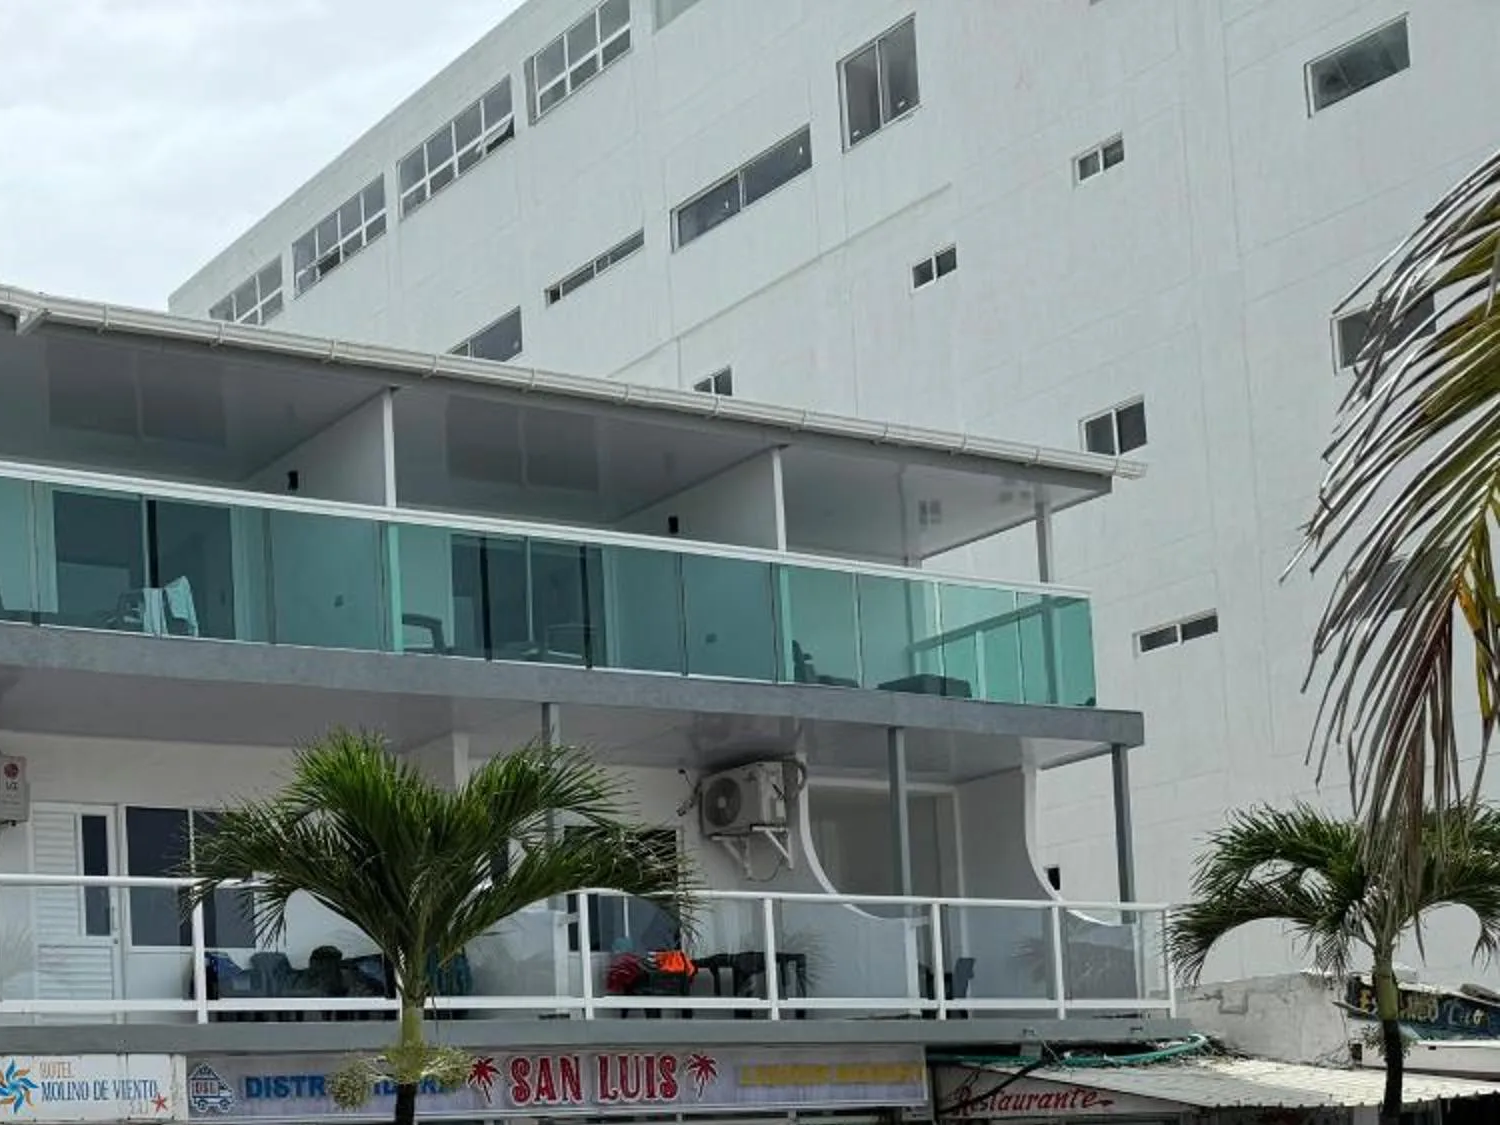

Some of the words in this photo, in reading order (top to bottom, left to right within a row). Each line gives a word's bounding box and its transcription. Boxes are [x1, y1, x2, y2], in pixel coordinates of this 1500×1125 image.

[39, 1061, 74, 1079] HOTEL
[509, 1055, 584, 1104] SAN
[597, 1053, 680, 1101] LUIS
[40, 1080, 89, 1102] MOLINO
[92, 1079, 109, 1101] DE
[113, 1078, 157, 1100] VIENTO
